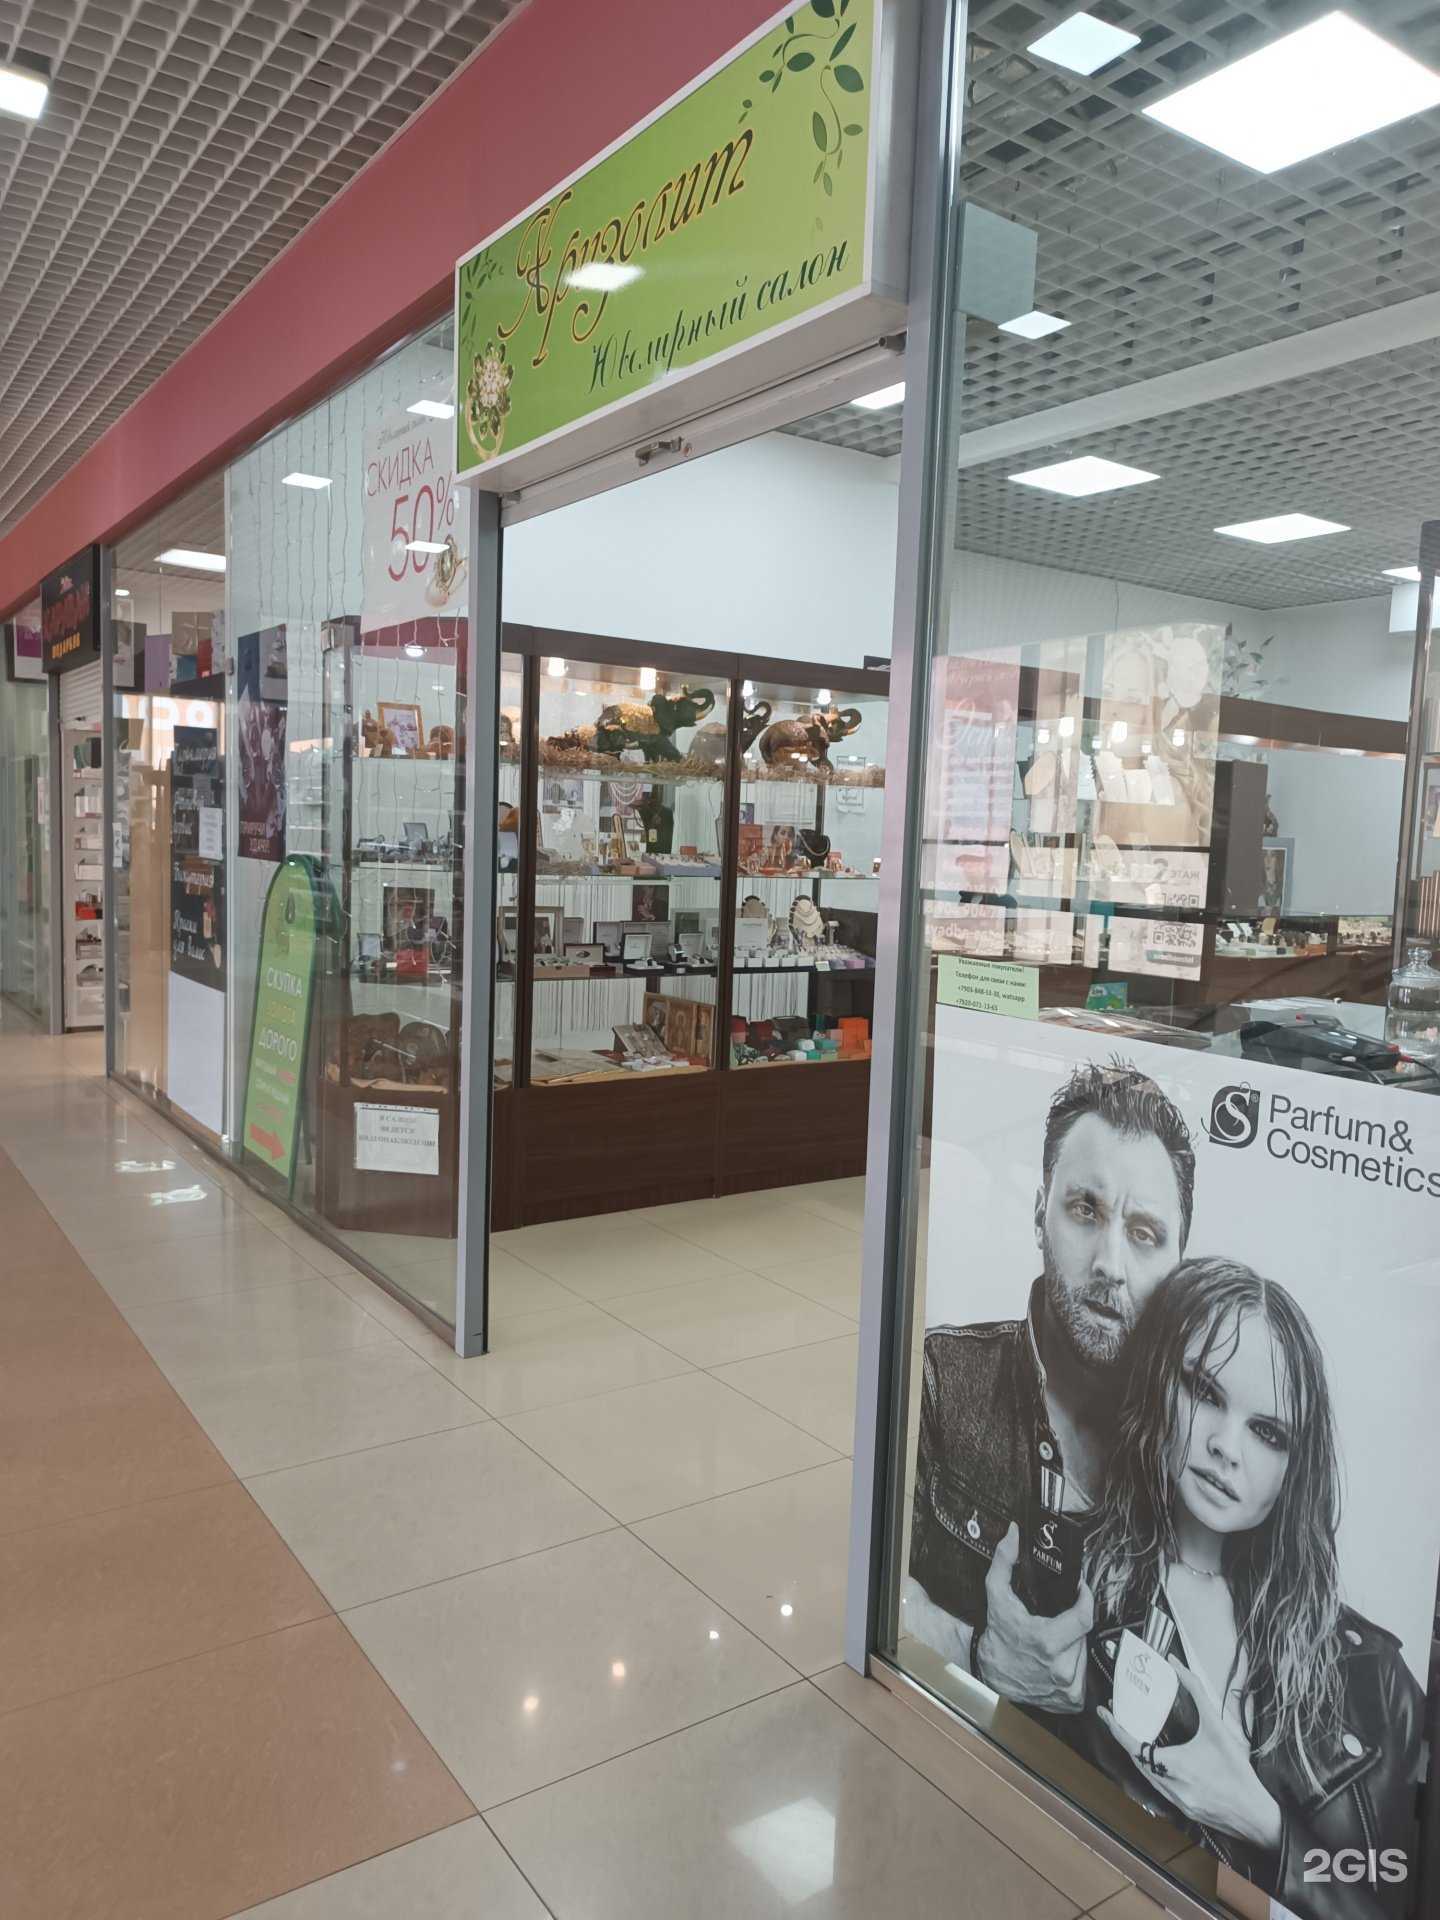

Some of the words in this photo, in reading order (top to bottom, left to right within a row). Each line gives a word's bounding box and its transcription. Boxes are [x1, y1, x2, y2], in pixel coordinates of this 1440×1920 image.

[497, 128, 754, 367] Хризолит
[587, 276, 748, 392] Ювелирный
[756, 239, 848, 310] салон
[367, 437, 434, 497] СКИДКА
[388, 471, 455, 581] 50%
[1170, 869, 1200, 880] ЭТАЖ
[266, 967, 304, 998] СКУПКА
[955, 970, 978, 979] Телефон
[258, 1026, 297, 1064] ДОРОГО
[1269, 1094, 1414, 1155] Parfum&
[1267, 1128, 1440, 1199] Cosmetics
